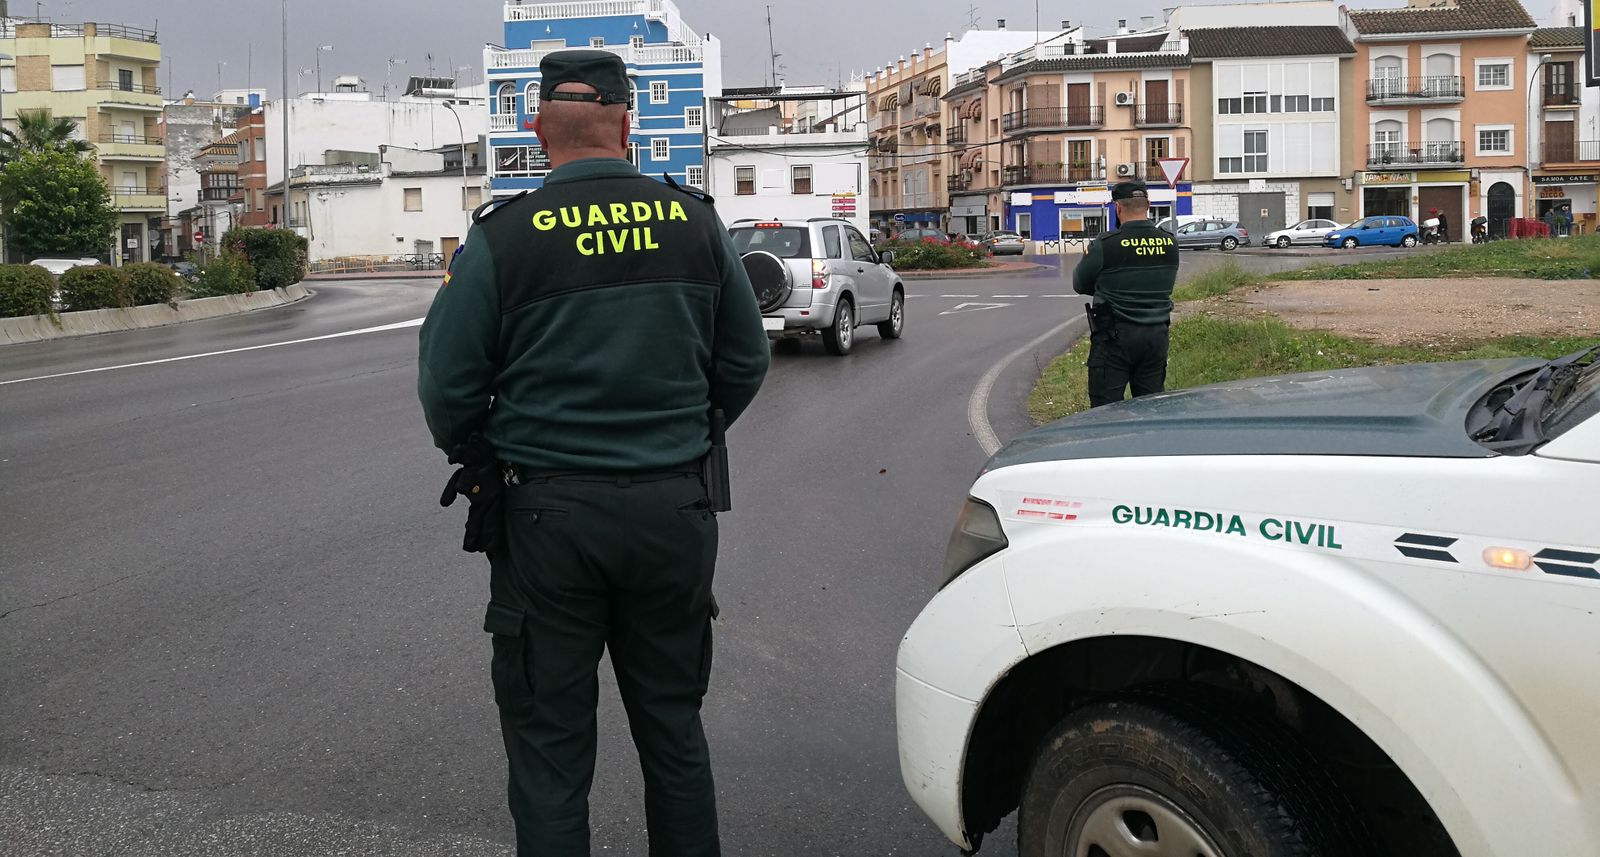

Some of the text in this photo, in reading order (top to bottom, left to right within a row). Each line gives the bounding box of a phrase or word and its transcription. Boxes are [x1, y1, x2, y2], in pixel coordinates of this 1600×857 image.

[532, 200, 688, 231] GUARDIA
[576, 227, 659, 256] CIVIL
[1120, 237, 1174, 247] GUARDIA
[1135, 246, 1166, 256] CIVIL
[1112, 504, 1343, 550] GUARDIA CIVIL
